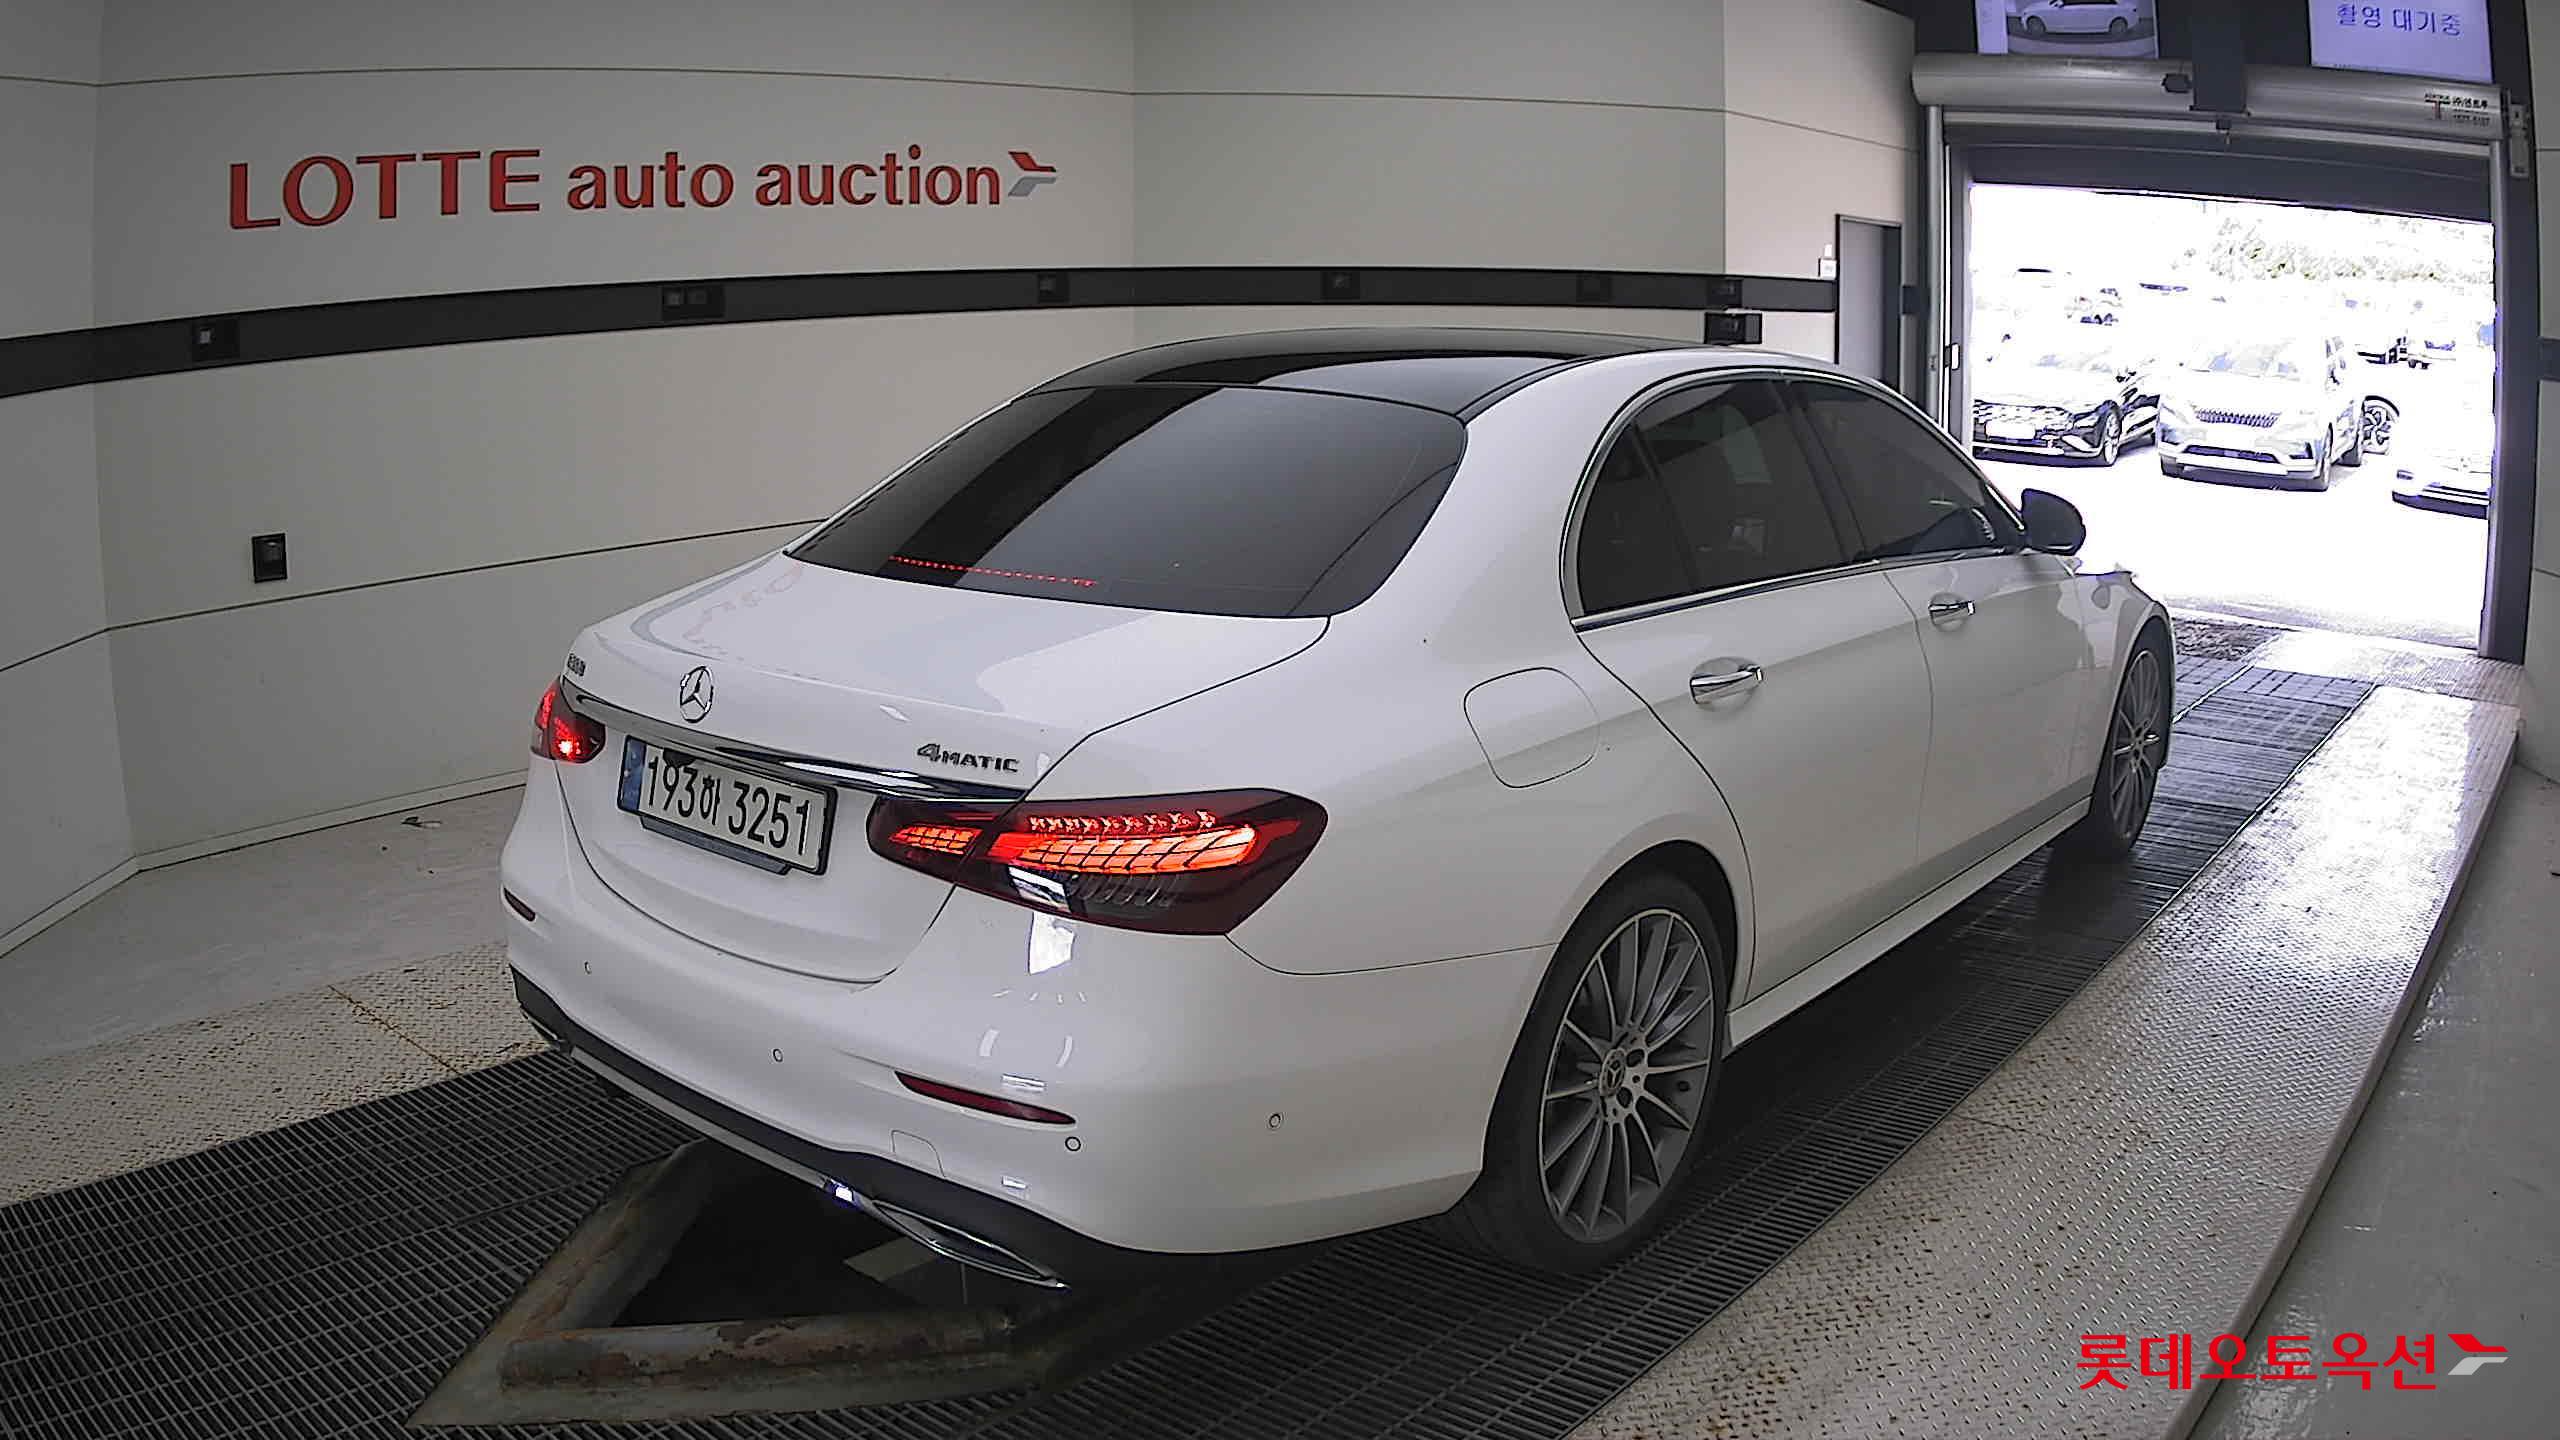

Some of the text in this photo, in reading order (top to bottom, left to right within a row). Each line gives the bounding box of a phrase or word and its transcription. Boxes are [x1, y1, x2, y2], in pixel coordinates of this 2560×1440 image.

[2392, 8, 2461, 36] 대기중
[229, 145, 1001, 230] LOTTE auto auction
[917, 743, 1020, 773] 4MATIC
[648, 756, 811, 856] 193하 3251
